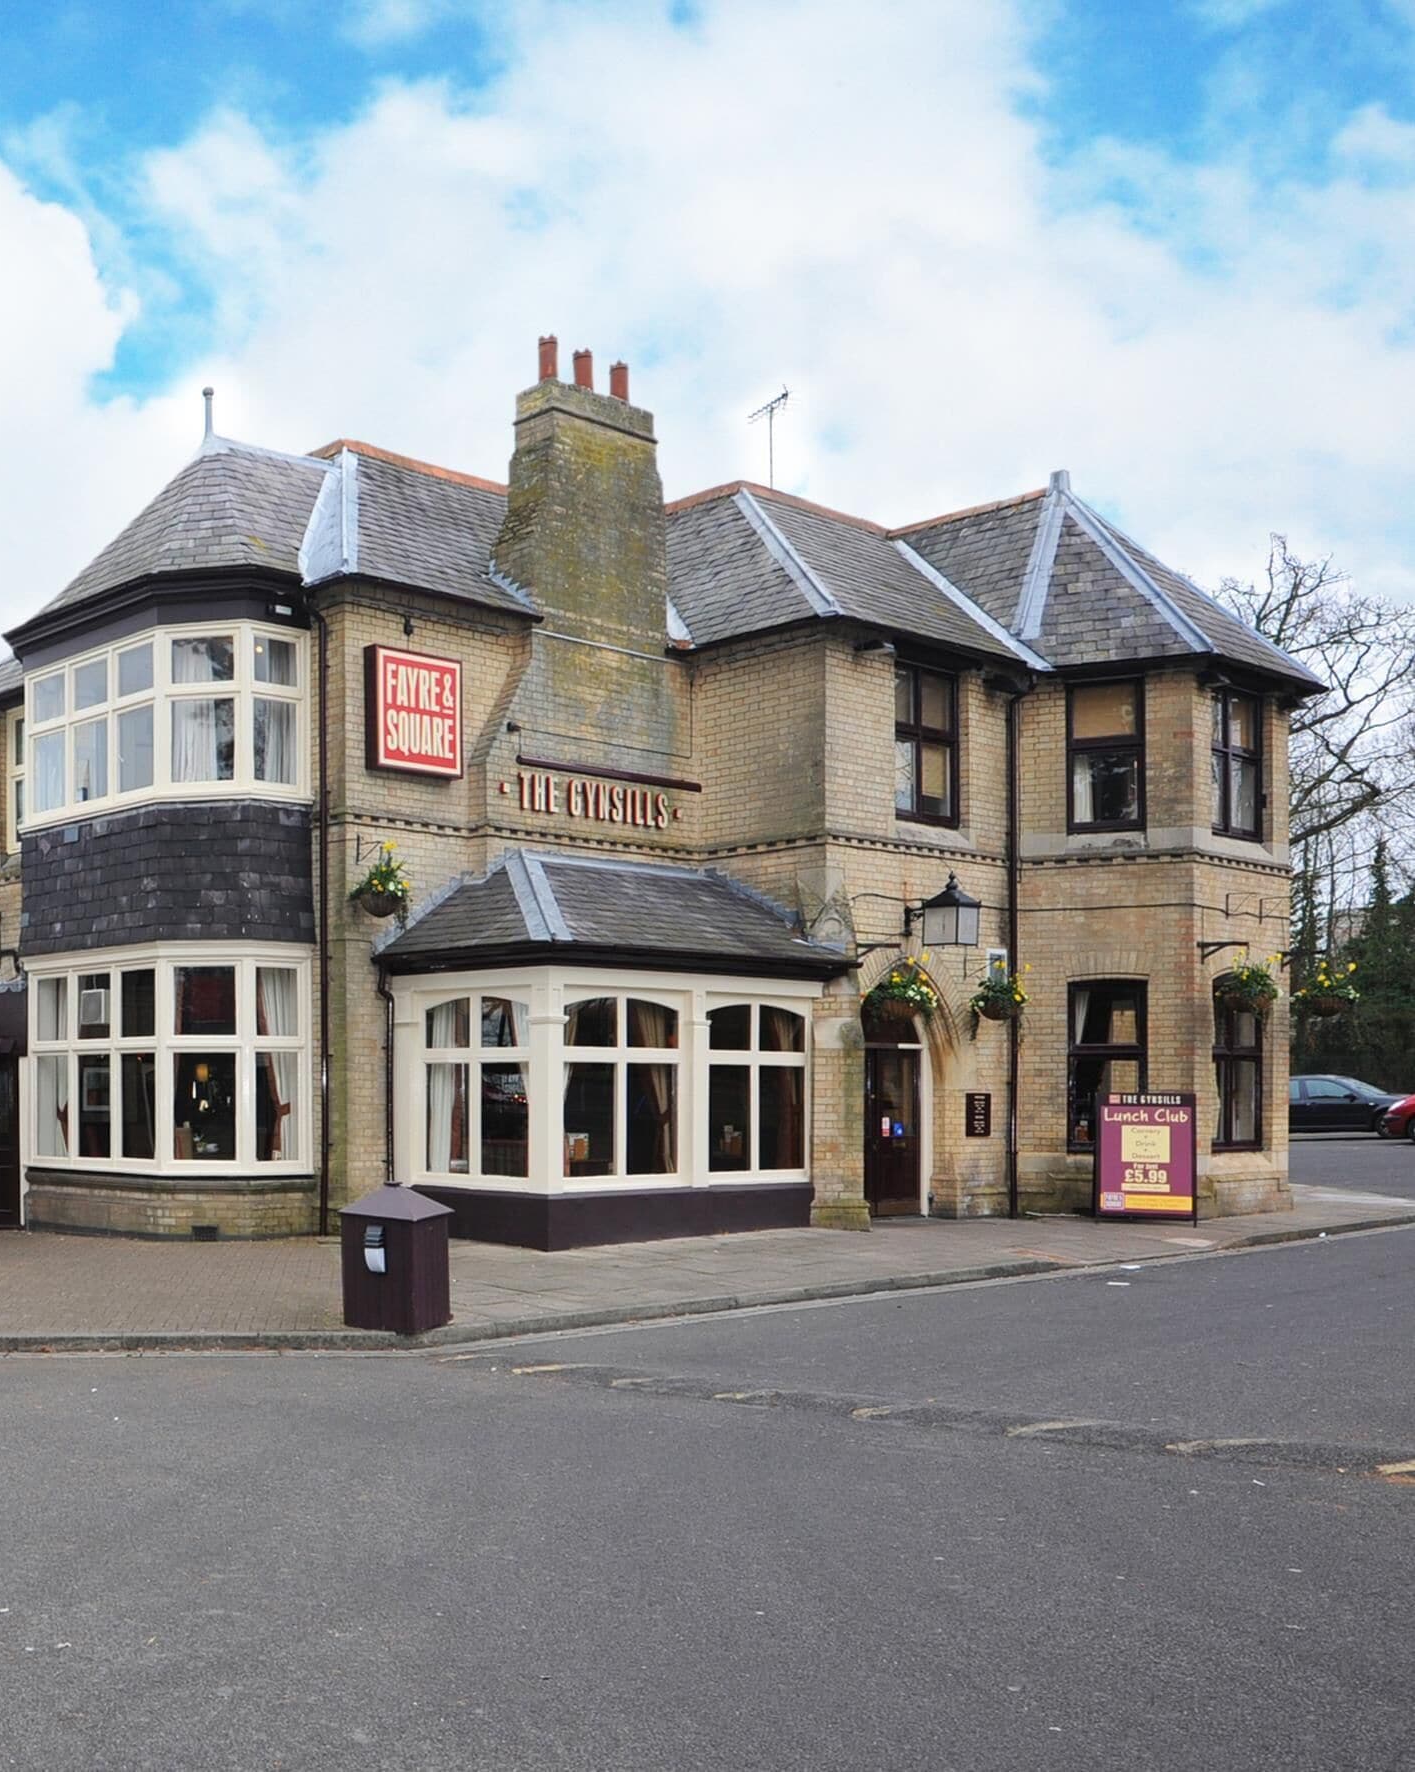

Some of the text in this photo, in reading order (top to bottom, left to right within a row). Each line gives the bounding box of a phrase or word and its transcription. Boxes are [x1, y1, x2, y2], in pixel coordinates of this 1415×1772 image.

[385, 662, 454, 714] FAYRE &
[386, 708, 454, 760] SQUARE
[518, 772, 668, 830] THE GYNSILLS
[1104, 1107, 1189, 1123] Lunch Club
[1124, 1169, 1167, 1184] £5.99
